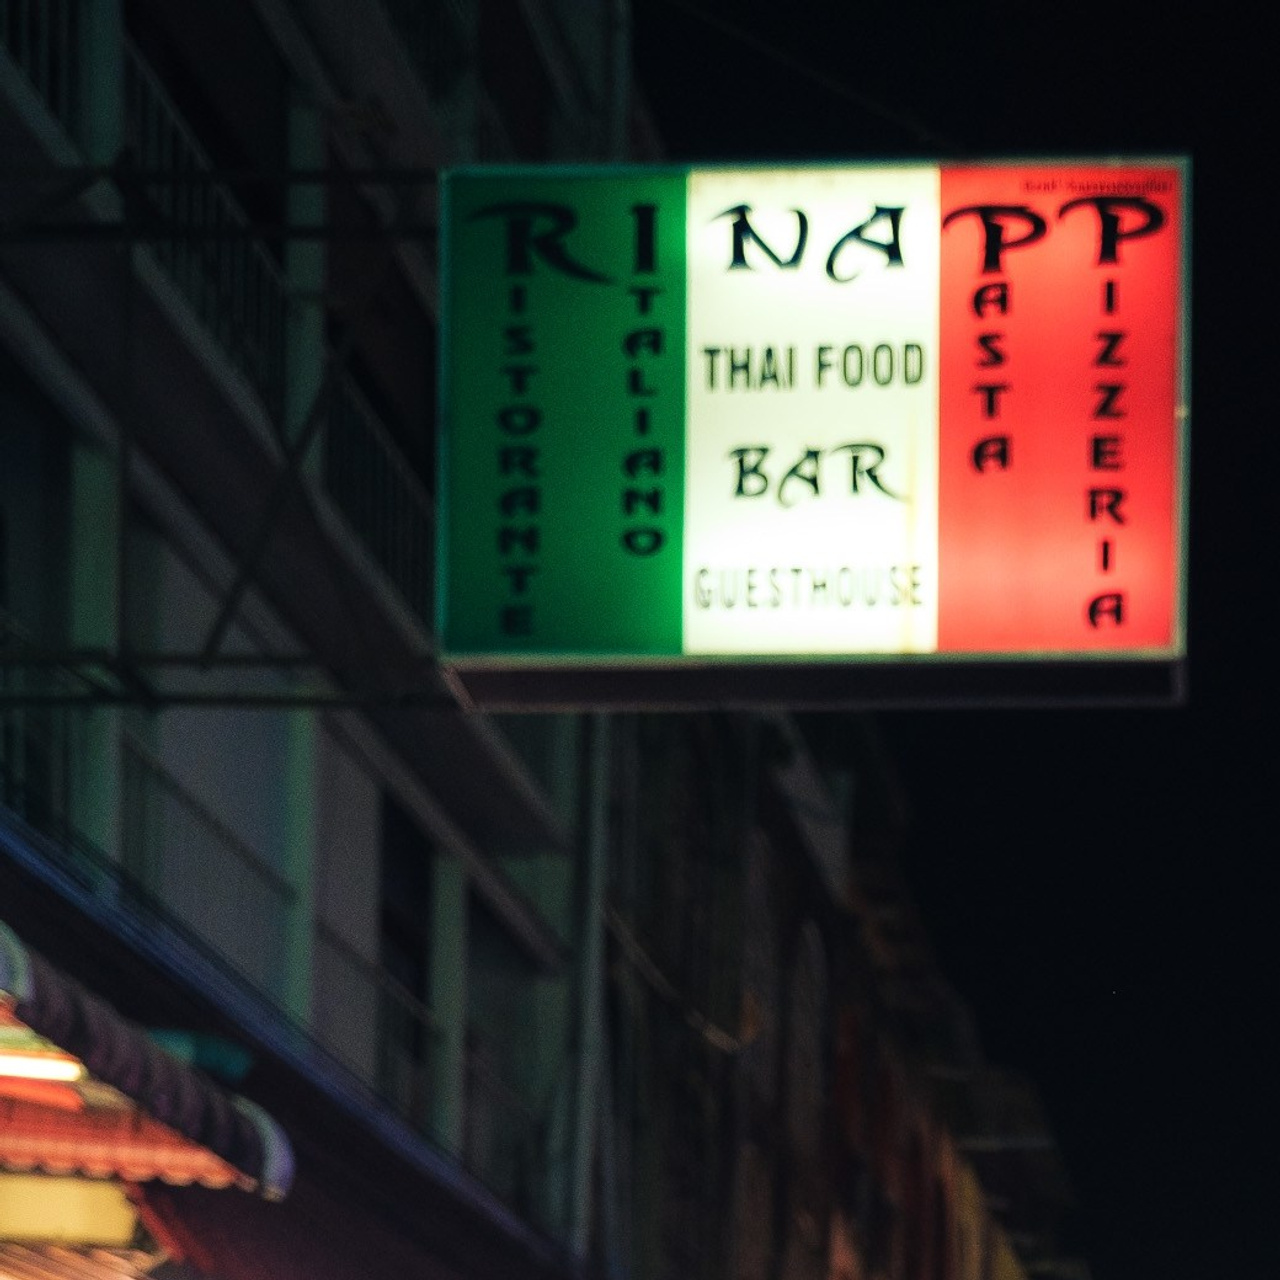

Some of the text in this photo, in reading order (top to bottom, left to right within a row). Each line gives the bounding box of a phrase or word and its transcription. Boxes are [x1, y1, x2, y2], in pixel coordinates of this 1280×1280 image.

[466, 203, 616, 637] RISTORANTE
[620, 204, 666, 558] ITALIANO
[703, 343, 926, 391] THAI FOOD
[943, 204, 1047, 474] PASTA
[1059, 196, 1167, 628] PIZZERIA
[694, 565, 926, 610] GUESTHOUSE
[729, 442, 911, 508] BAR
